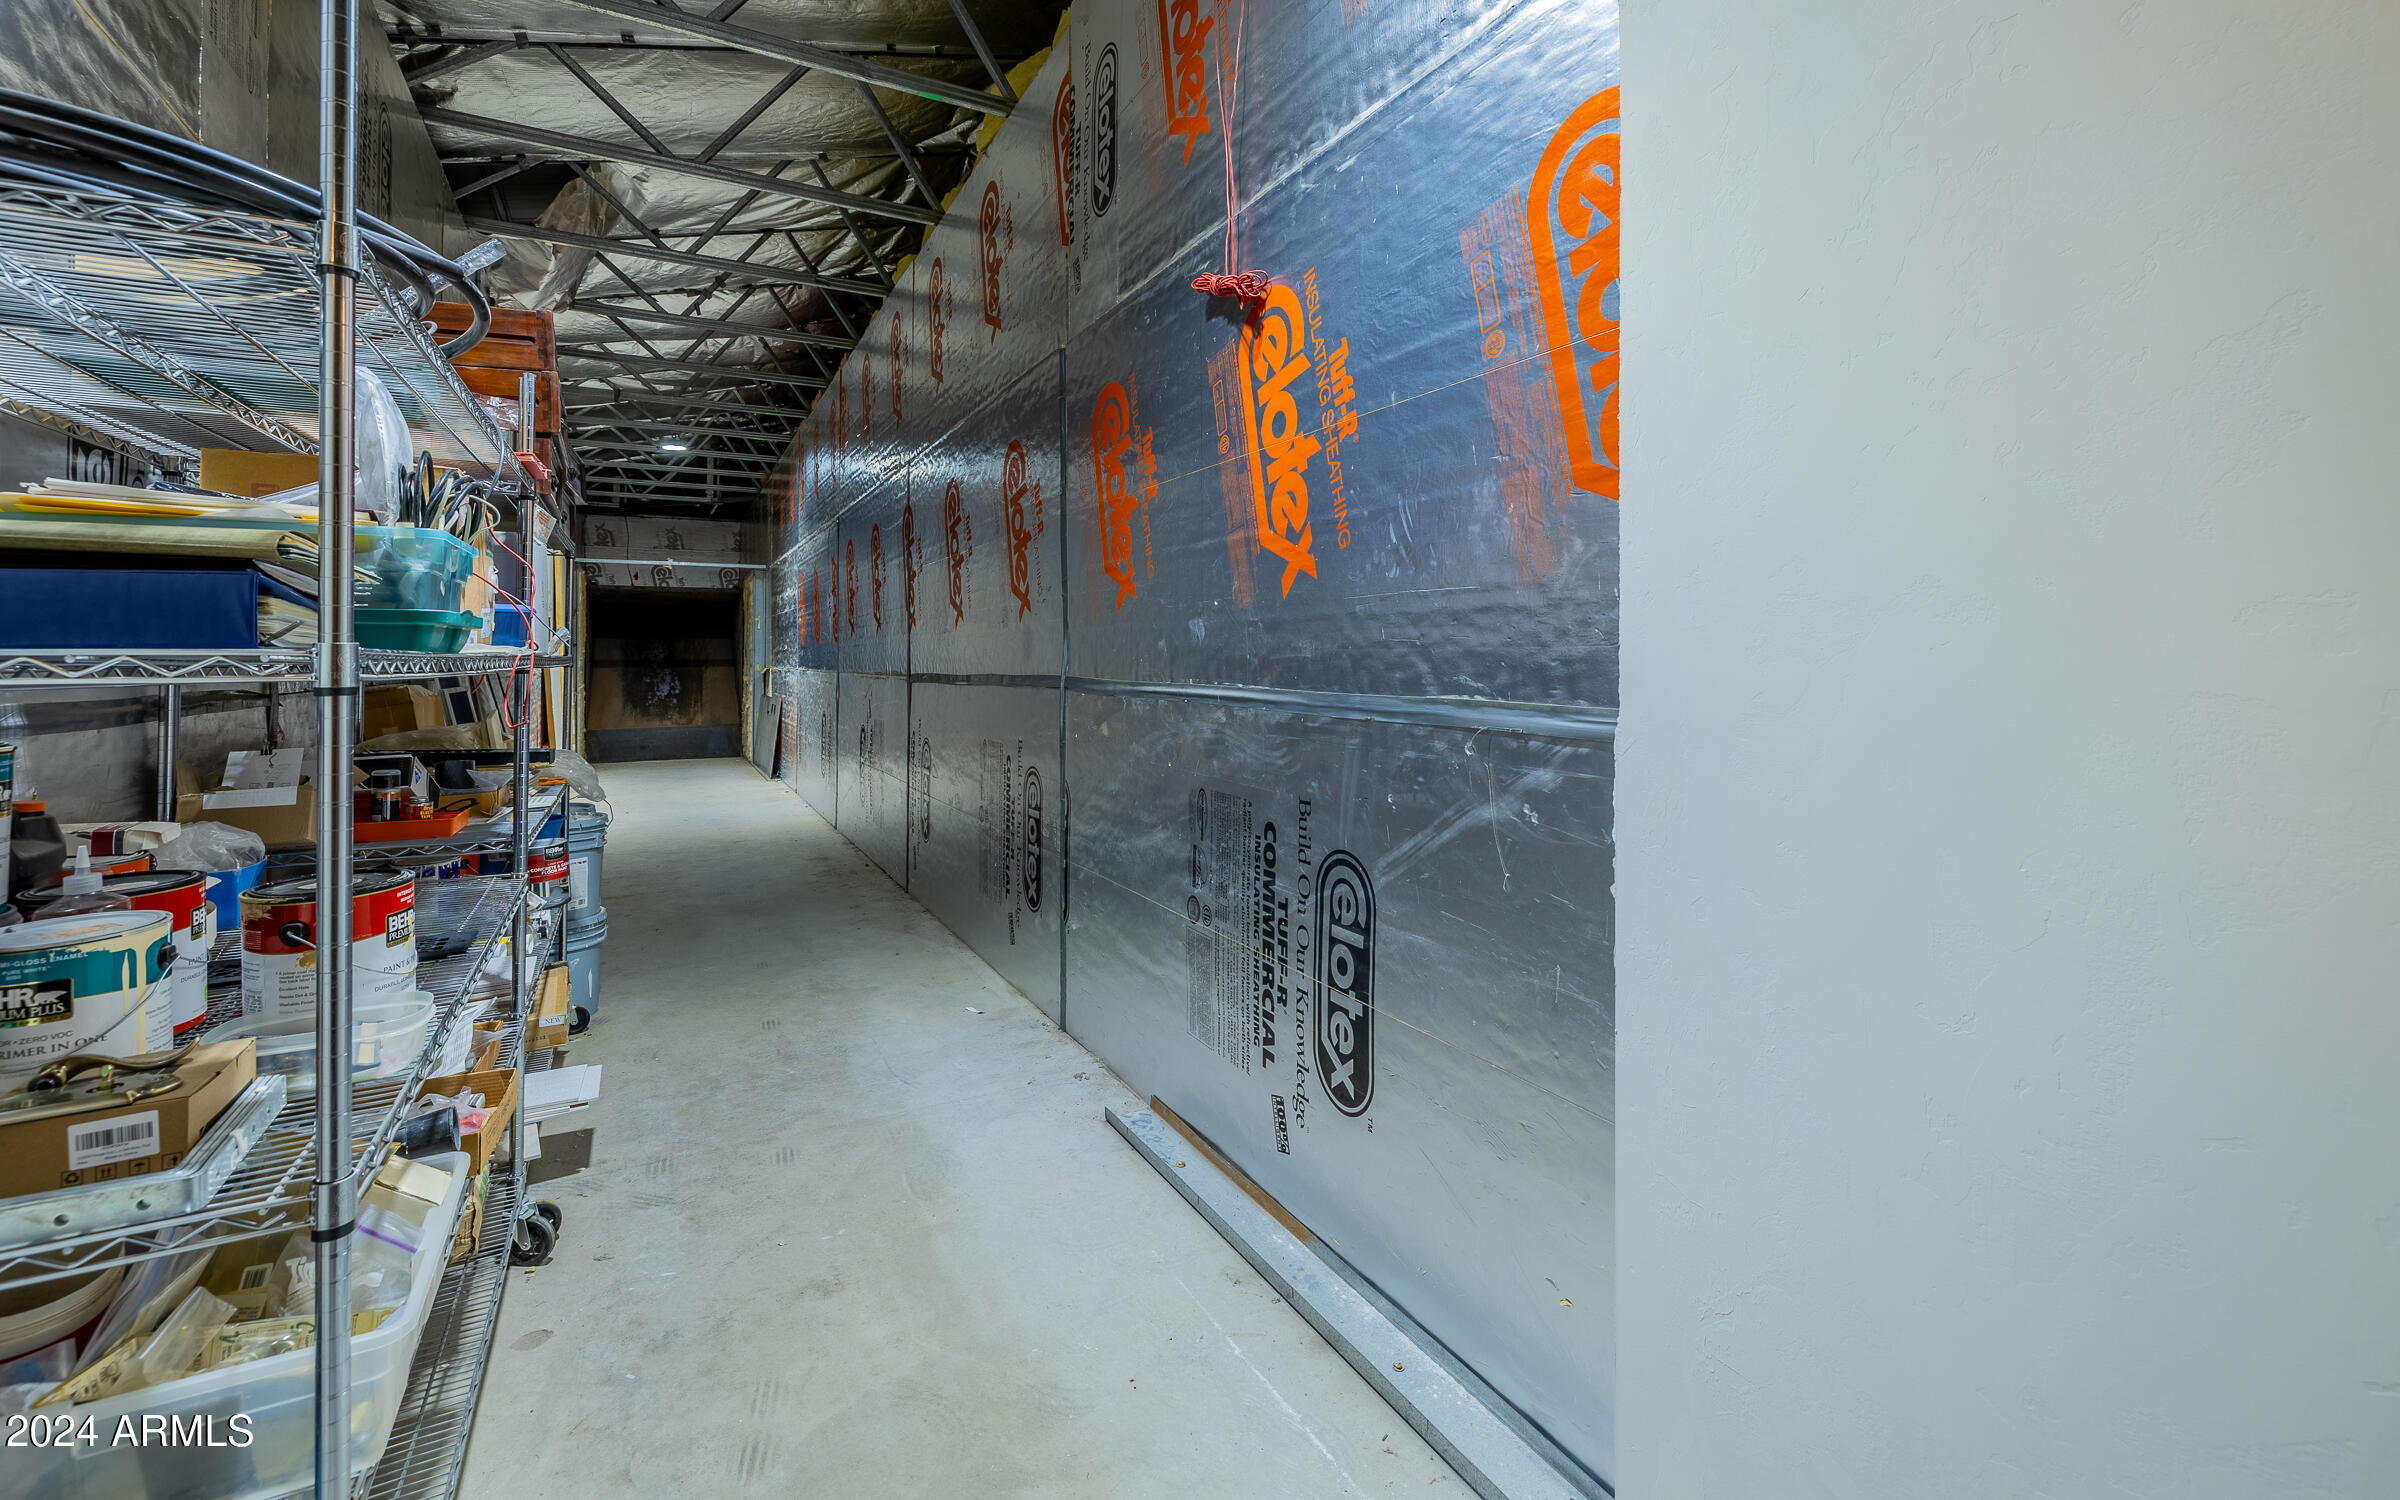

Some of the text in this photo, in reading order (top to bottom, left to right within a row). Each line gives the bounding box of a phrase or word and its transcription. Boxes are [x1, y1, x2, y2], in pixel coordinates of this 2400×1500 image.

[1095, 46, 1116, 206] Celotex
[929, 257, 945, 393] Celotex
[980, 180, 1003, 345] Celotex
[1142, 426, 1158, 500] Tuff-R
[1238, 284, 1322, 600] Celotex
[1304, 266, 1351, 550] INSULATING SHEATHING
[1329, 337, 1358, 443] Tuff-R
[944, 477, 964, 631] Celotex
[1003, 440, 1033, 624] Celotex
[1092, 381, 1139, 613] Celotex
[1025, 771, 1041, 902] Celotex
[0, 987, 36, 1010] HR
[31, 1002, 65, 1018] PLUS
[50, 952, 89, 963] ENAMEL
[383, 960, 405, 973] PAINT
[1253, 834, 1262, 1048] INSULATING SHEATHING
[1262, 821, 1277, 1069] COMMERCIAL
[1277, 897, 1289, 1008] TUFF-R
[1292, 797, 1312, 1129] Build On Our Knowledge
[1320, 864, 1368, 1100] Celotex
[0, 1033, 108, 1061] RIMER IN ONE
